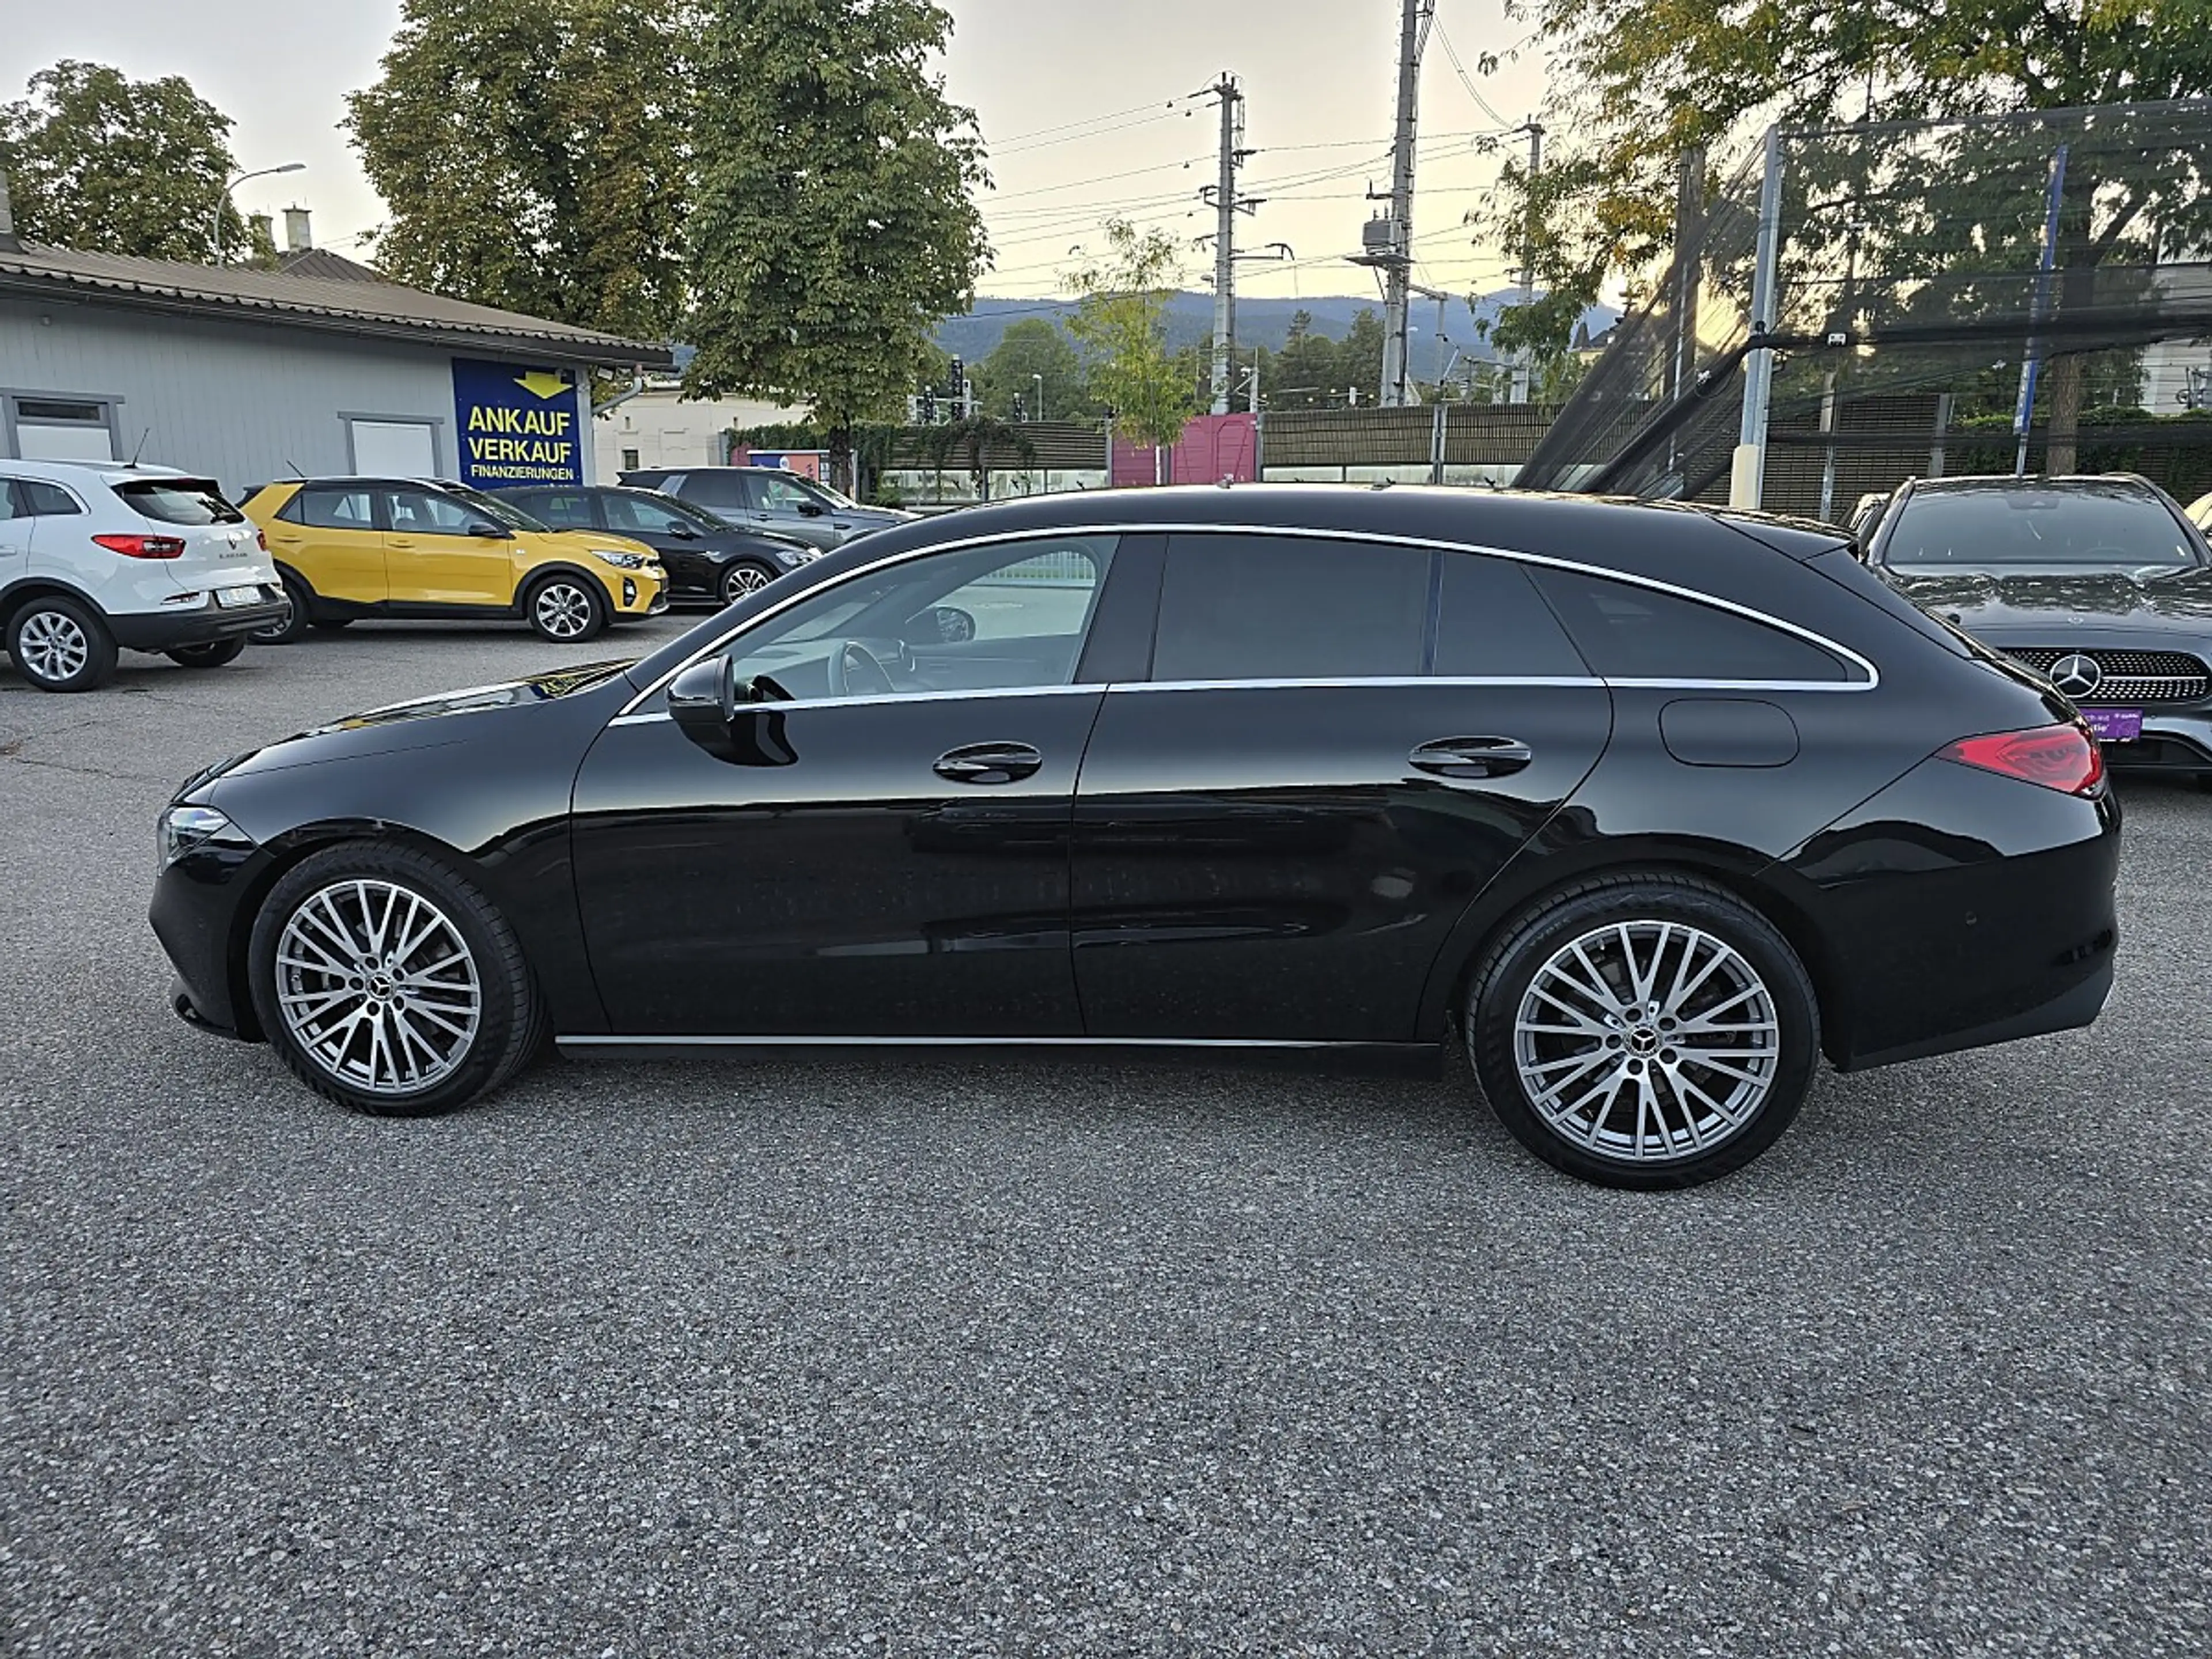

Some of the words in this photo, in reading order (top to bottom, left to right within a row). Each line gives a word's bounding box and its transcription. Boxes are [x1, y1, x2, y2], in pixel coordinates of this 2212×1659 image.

[468, 406, 571, 435] ANKAUF
[468, 437, 571, 463] VERKAUF
[471, 465, 574, 480] FINANZIERUNGEN
